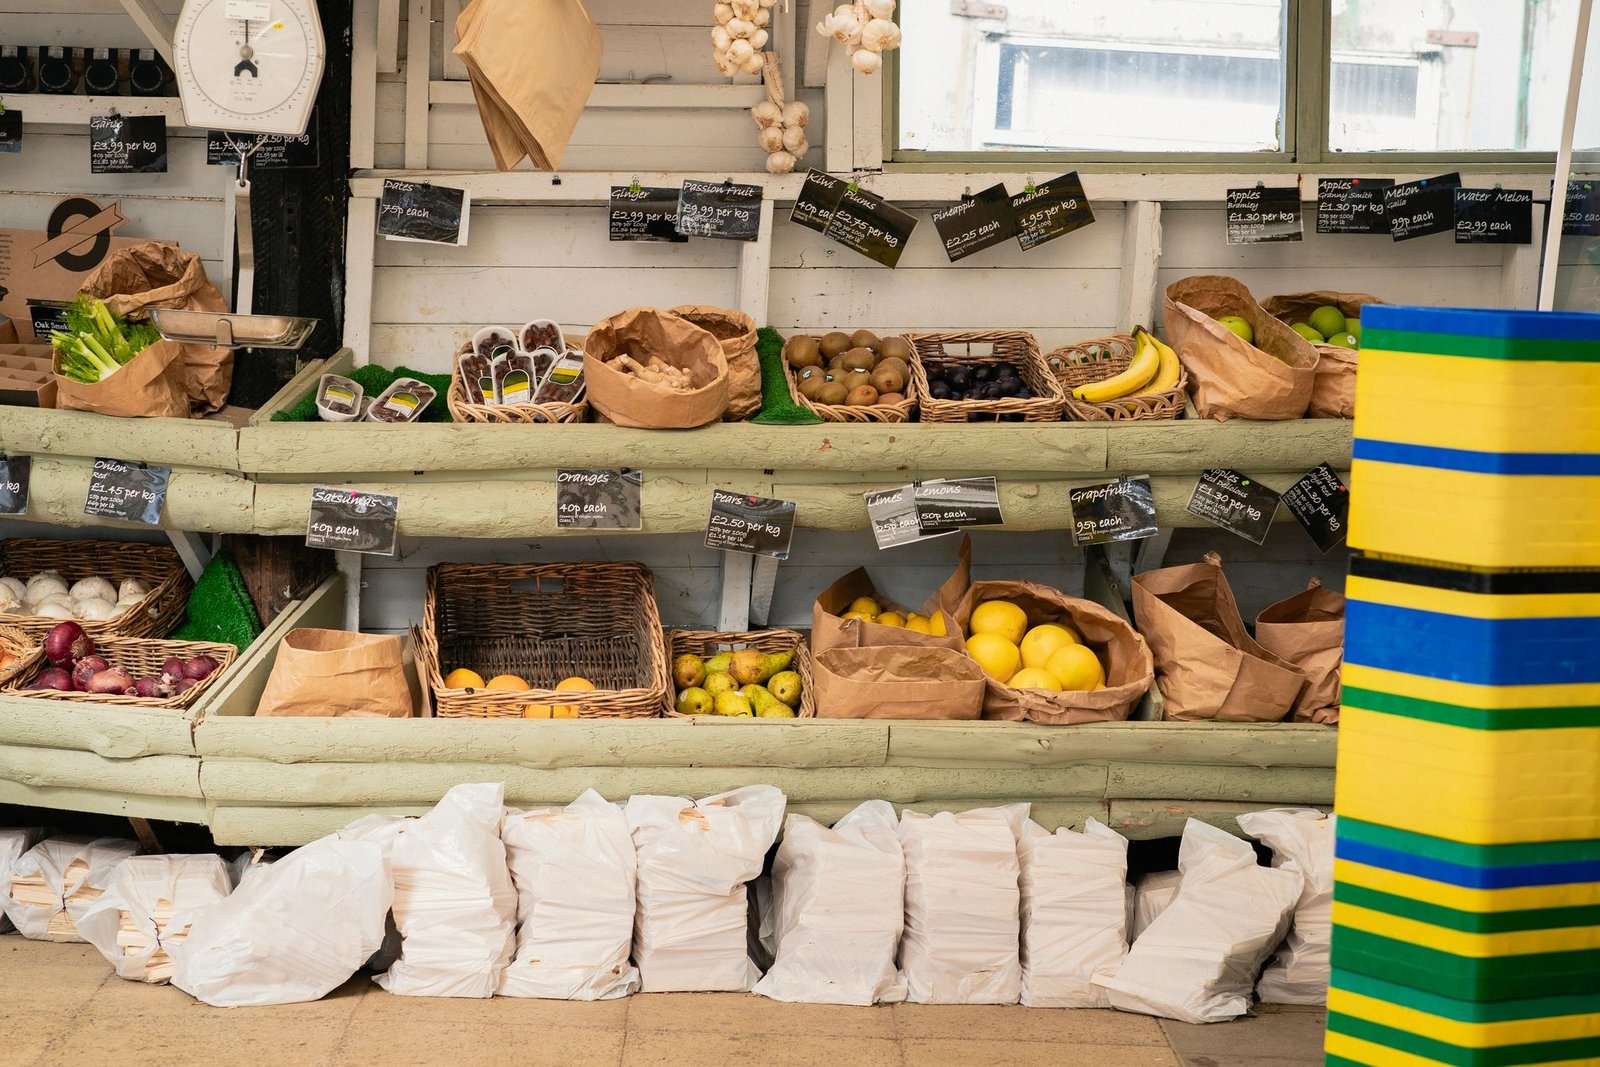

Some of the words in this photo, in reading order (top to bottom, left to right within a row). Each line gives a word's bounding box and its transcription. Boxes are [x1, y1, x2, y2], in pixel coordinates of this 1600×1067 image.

[92, 141, 123, 154] £3.99
[125, 142, 141, 150] per
[142, 140, 156, 152] kg
[384, 180, 414, 192] Dates
[807, 173, 837, 189] Kiwi
[1318, 181, 1352, 192] Apples
[611, 188, 650, 201] Ginger
[684, 182, 725, 194] Passion
[726, 187, 754, 196] Fruit
[1385, 186, 1420, 200] Melon
[844, 190, 876, 210] Plums
[1012, 186, 1050, 208] ananas
[1227, 190, 1260, 203] Apples
[1318, 193, 1348, 202] Granny
[1456, 192, 1492, 201] Water
[1495, 193, 1530, 202] Melon
[382, 204, 404, 218] 75p
[406, 208, 430, 218] each
[683, 204, 714, 218] £9.99
[716, 208, 732, 219] per
[734, 208, 748, 222] kg
[798, 201, 816, 216] 40p
[818, 209, 834, 220] eac
[933, 200, 976, 222] Pineapple
[1021, 210, 1044, 228] 1.95
[1045, 205, 1060, 220] per
[1061, 199, 1076, 210] kg
[1228, 201, 1258, 212] Bramley
[1320, 202, 1350, 211] £1.30
[1352, 204, 1367, 215] per
[1370, 202, 1384, 214] kg
[612, 211, 644, 223] £2.99
[646, 214, 662, 224] per
[664, 212, 678, 224] kg
[1229, 212, 1260, 222] £1.30
[1262, 213, 1278, 224] per
[1280, 211, 1294, 224] kg
[1391, 218, 1410, 231] 99p
[1412, 210, 1434, 223] each
[836, 210, 869, 230] £2.75
[867, 226, 886, 238] per
[884, 232, 898, 248] kg
[946, 229, 977, 248] £2.25
[978, 220, 1000, 235] each
[1456, 221, 1488, 234] £2.99
[1490, 221, 1512, 230] each
[94, 461, 128, 473] Onion
[93, 472, 108, 480] Red
[558, 472, 610, 486] Oranges
[1210, 468, 1240, 484] pples
[1316, 466, 1340, 490] Apples
[6, 480, 20, 494] kg
[914, 486, 961, 498] Lemons
[1071, 482, 1133, 503] Grapefruit
[1202, 473, 1218, 483] Red
[1216, 480, 1248, 498] Delicious
[90, 482, 125, 495] £1.45
[124, 489, 141, 500] per
[142, 490, 156, 504] kg
[714, 492, 743, 505] Pears
[867, 492, 903, 507] Limes
[558, 503, 581, 516] 40p
[584, 502, 607, 512] each
[1198, 484, 1228, 502] £1.30
[1228, 498, 1246, 511] per
[1246, 504, 1261, 520] kg
[1300, 480, 1322, 504] £1.30
[1316, 503, 1332, 516] per
[1328, 514, 1340, 532] kg
[921, 512, 942, 522] 50p
[944, 510, 968, 519] each
[310, 522, 333, 536] 40p
[335, 526, 360, 536] each
[711, 514, 744, 528] £2.50
[746, 522, 764, 533] per
[766, 522, 780, 538] kg
[876, 524, 897, 535] 25p
[1076, 520, 1097, 534] 95p
[1100, 516, 1122, 528] each
